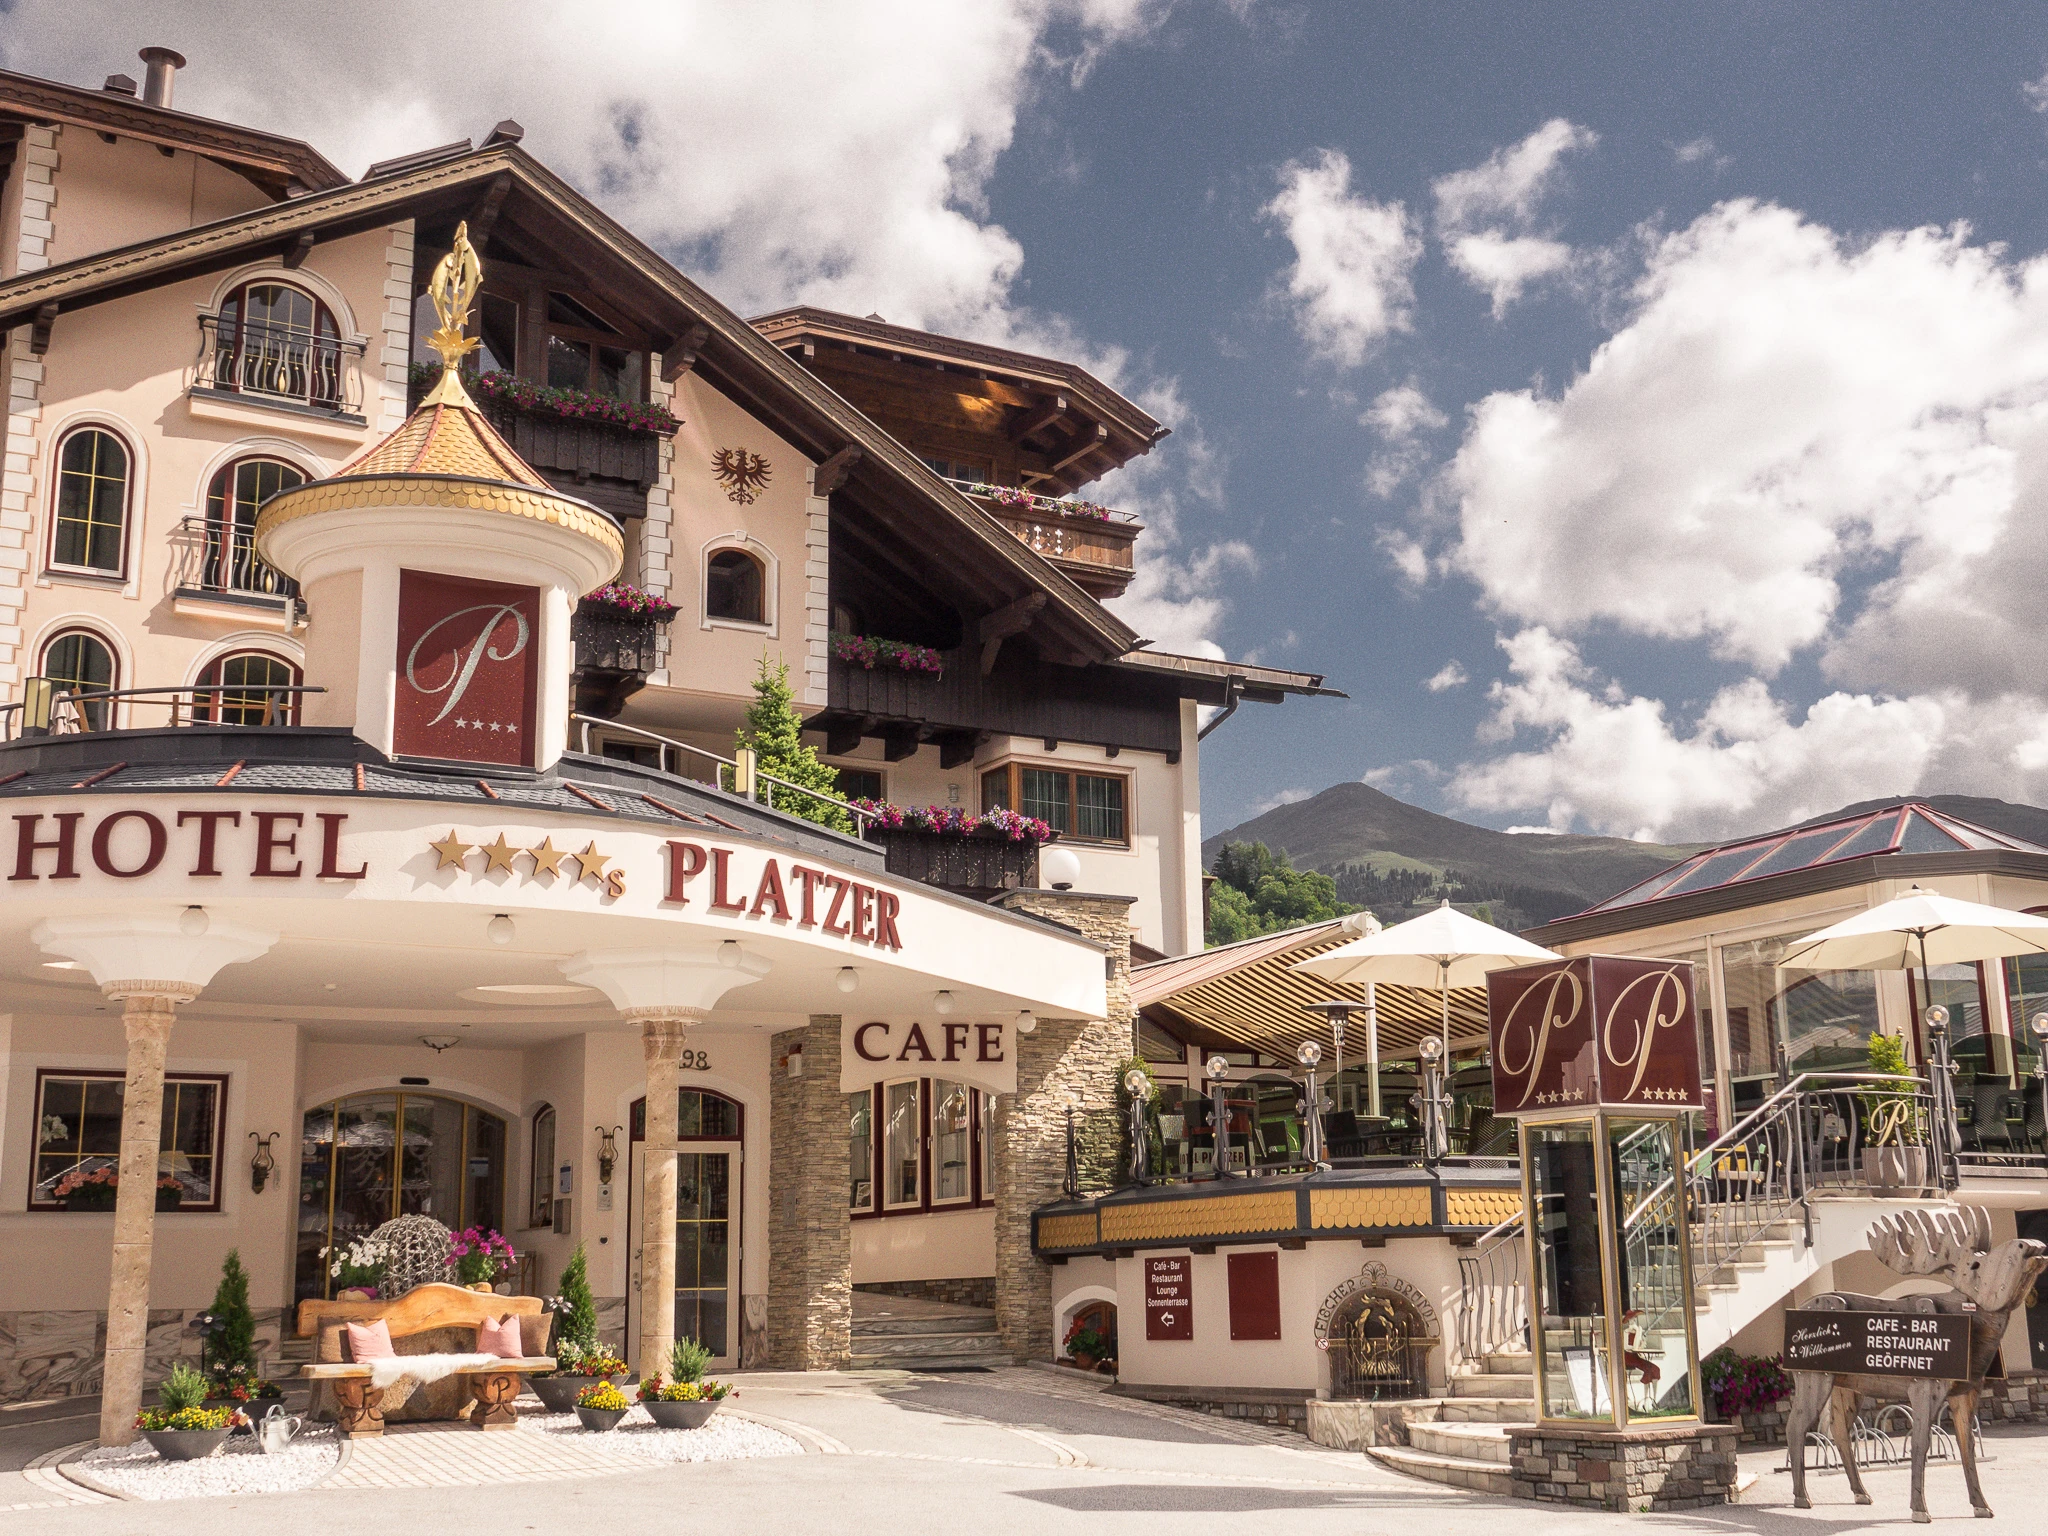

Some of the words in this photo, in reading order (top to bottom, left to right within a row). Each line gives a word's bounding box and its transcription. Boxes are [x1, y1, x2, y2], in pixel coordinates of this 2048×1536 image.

[7, 810, 368, 881] HOTEL
[664, 840, 903, 949] PLATZER
[854, 1022, 1004, 1062] CAFE
[1153, 1261, 1167, 1271] Café
[1170, 1260, 1181, 1270] Bar
[1151, 1273, 1183, 1283] Restaurant
[1156, 1286, 1178, 1296] Lounge
[1147, 1297, 1189, 1307] Sonnenterrasse
[1316, 1279, 1355, 1332] FISCHER
[1791, 1323, 1831, 1343] Herzlich
[1866, 1318, 1899, 1332] CAFE
[1911, 1319, 1938, 1334] BAR
[1799, 1341, 1852, 1359] Willkommen
[1866, 1335, 1951, 1352] RESTAURANT
[1865, 1352, 1934, 1370] GEÖFFNET
